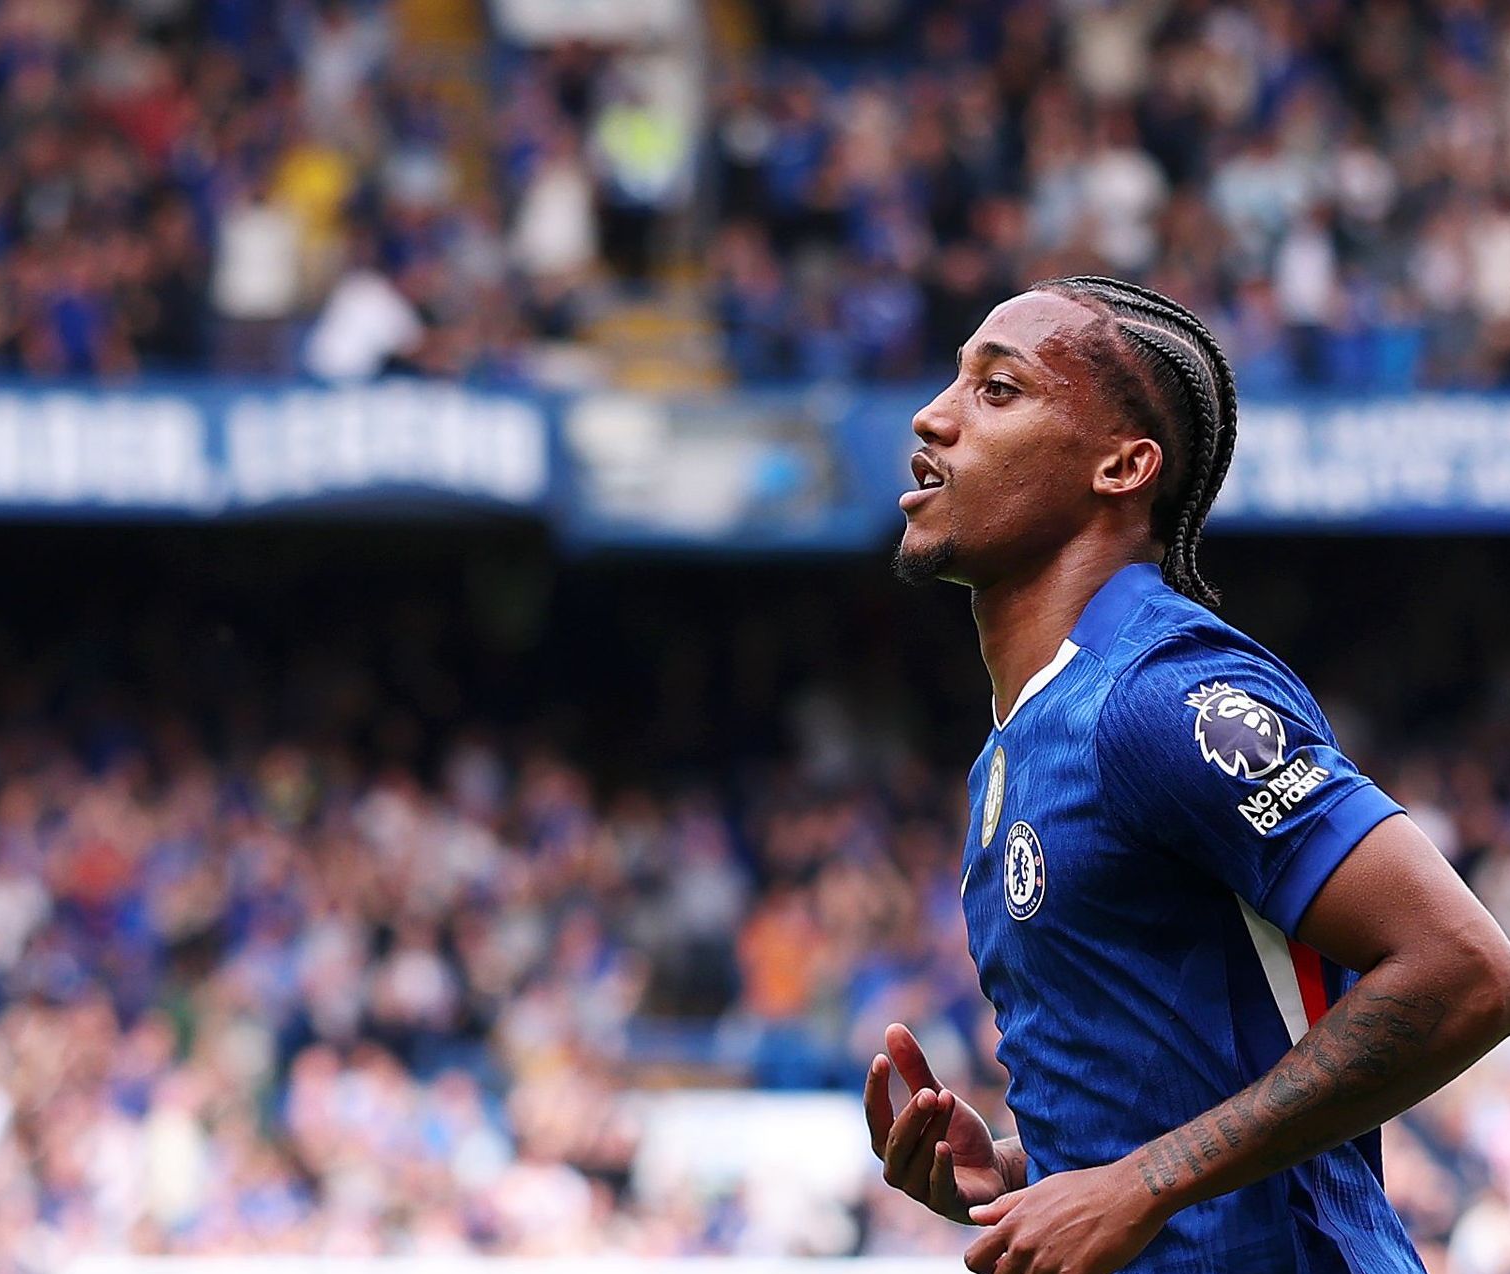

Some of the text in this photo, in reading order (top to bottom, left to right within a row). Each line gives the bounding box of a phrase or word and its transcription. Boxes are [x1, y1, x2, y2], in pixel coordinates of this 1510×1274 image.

[1237, 758, 1309, 823] No room
[1252, 802, 1283, 836] for
